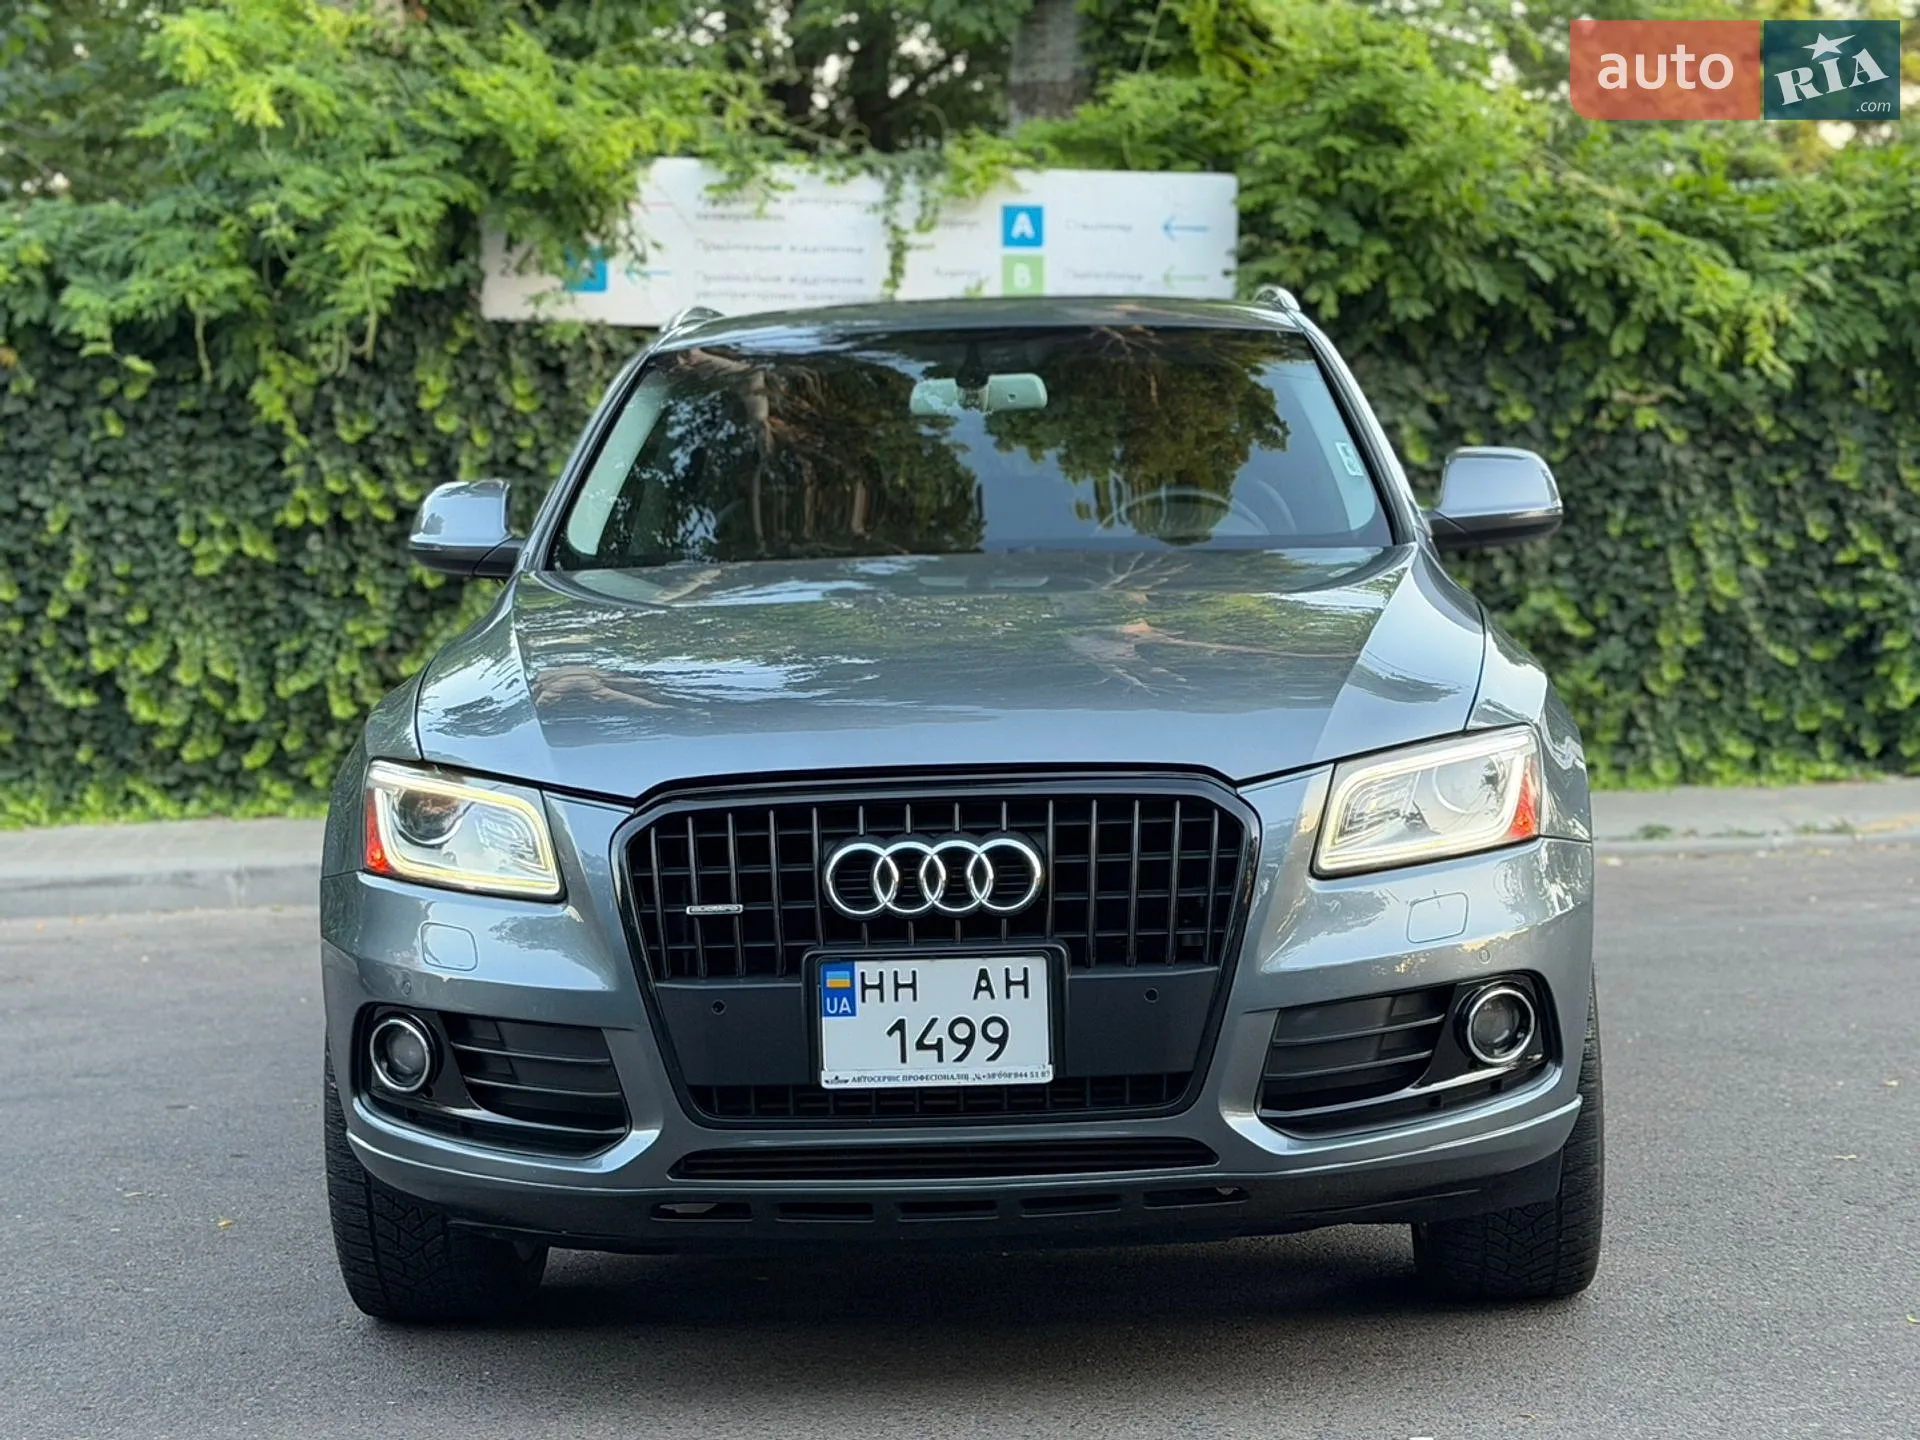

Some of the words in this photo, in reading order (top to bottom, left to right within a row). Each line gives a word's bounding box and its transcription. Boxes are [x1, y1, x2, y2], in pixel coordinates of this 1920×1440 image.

[1010, 211, 1036, 240] A
[860, 970, 918, 1003] HH
[972, 966, 1030, 1000] AH
[826, 997, 851, 1014] UA
[886, 1015, 1010, 1064] 1499
